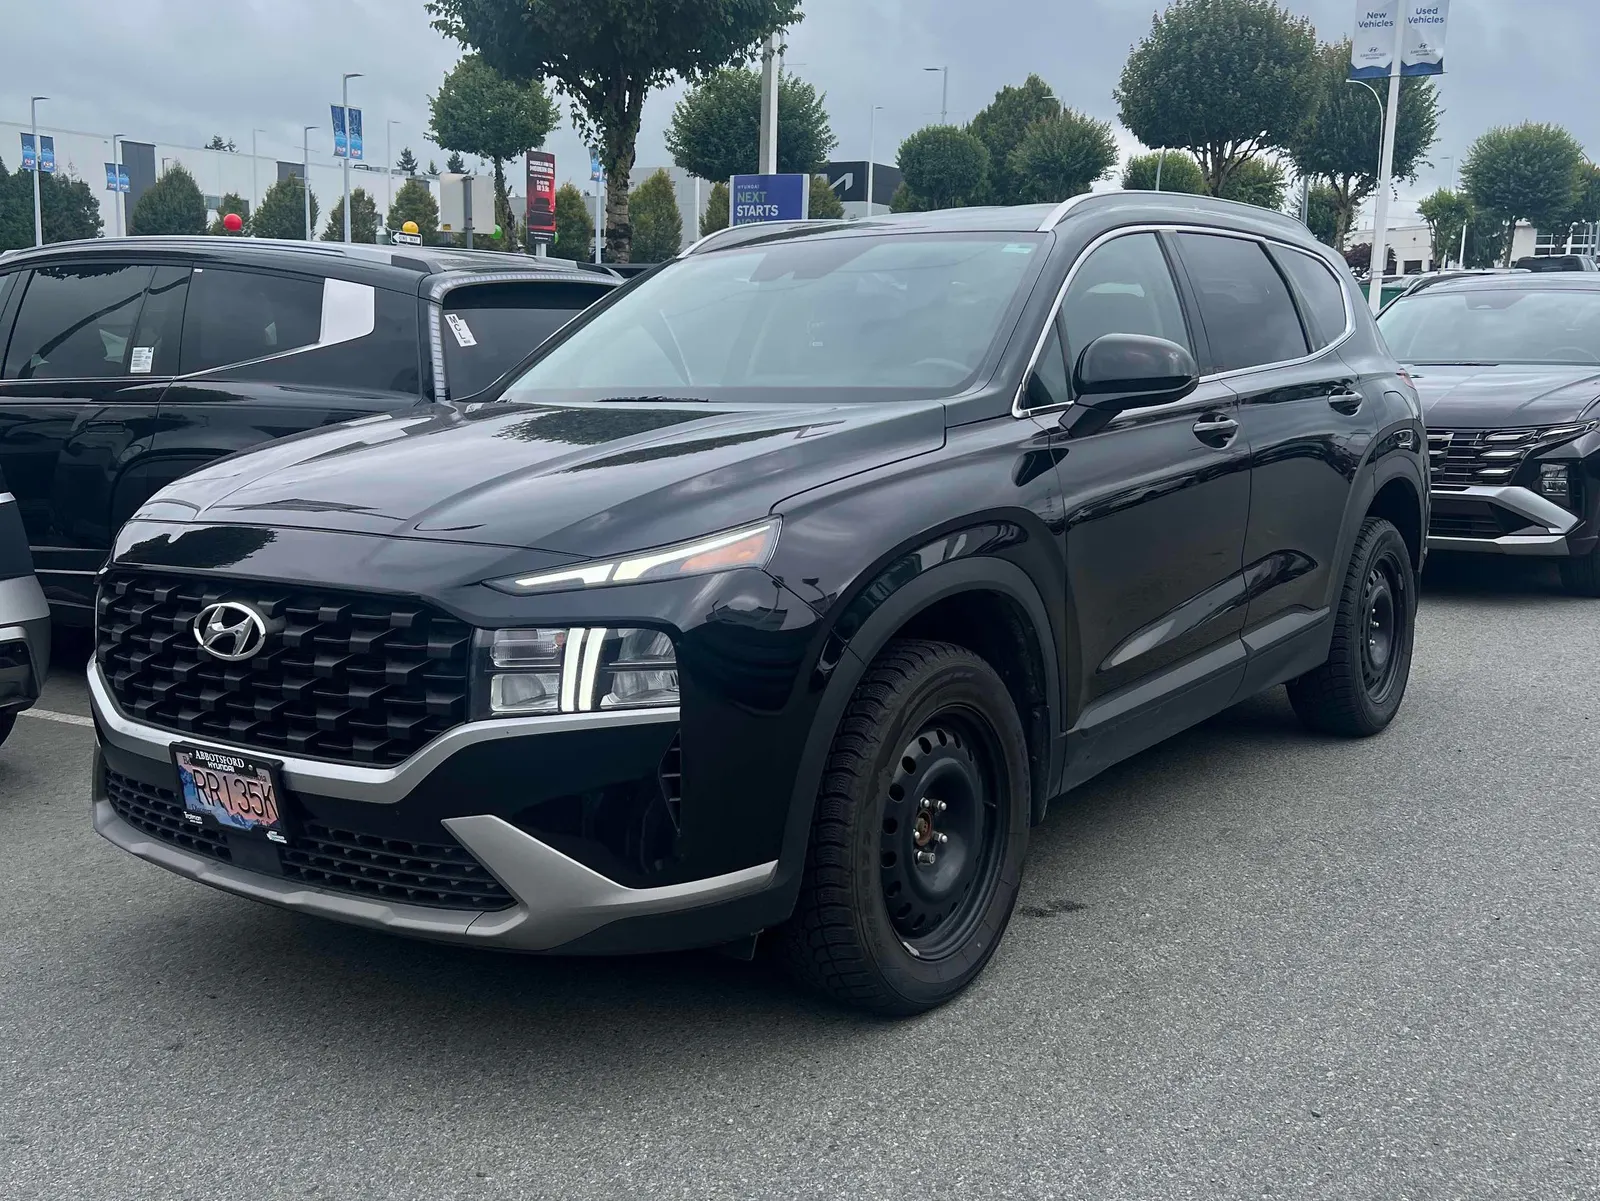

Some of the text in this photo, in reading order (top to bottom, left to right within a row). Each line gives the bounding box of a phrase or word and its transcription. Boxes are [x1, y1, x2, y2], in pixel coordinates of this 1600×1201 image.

[1415, 7, 1438, 15] Used
[1358, 20, 1394, 28] Vehicles
[1408, 16, 1444, 24] Vehicles
[737, 191, 767, 203] NEXT
[736, 204, 779, 217] STARTS
[195, 749, 245, 768] ABBOTSFORD
[207, 761, 235, 772] HYUNDAI
[192, 768, 280, 820] RR135K
